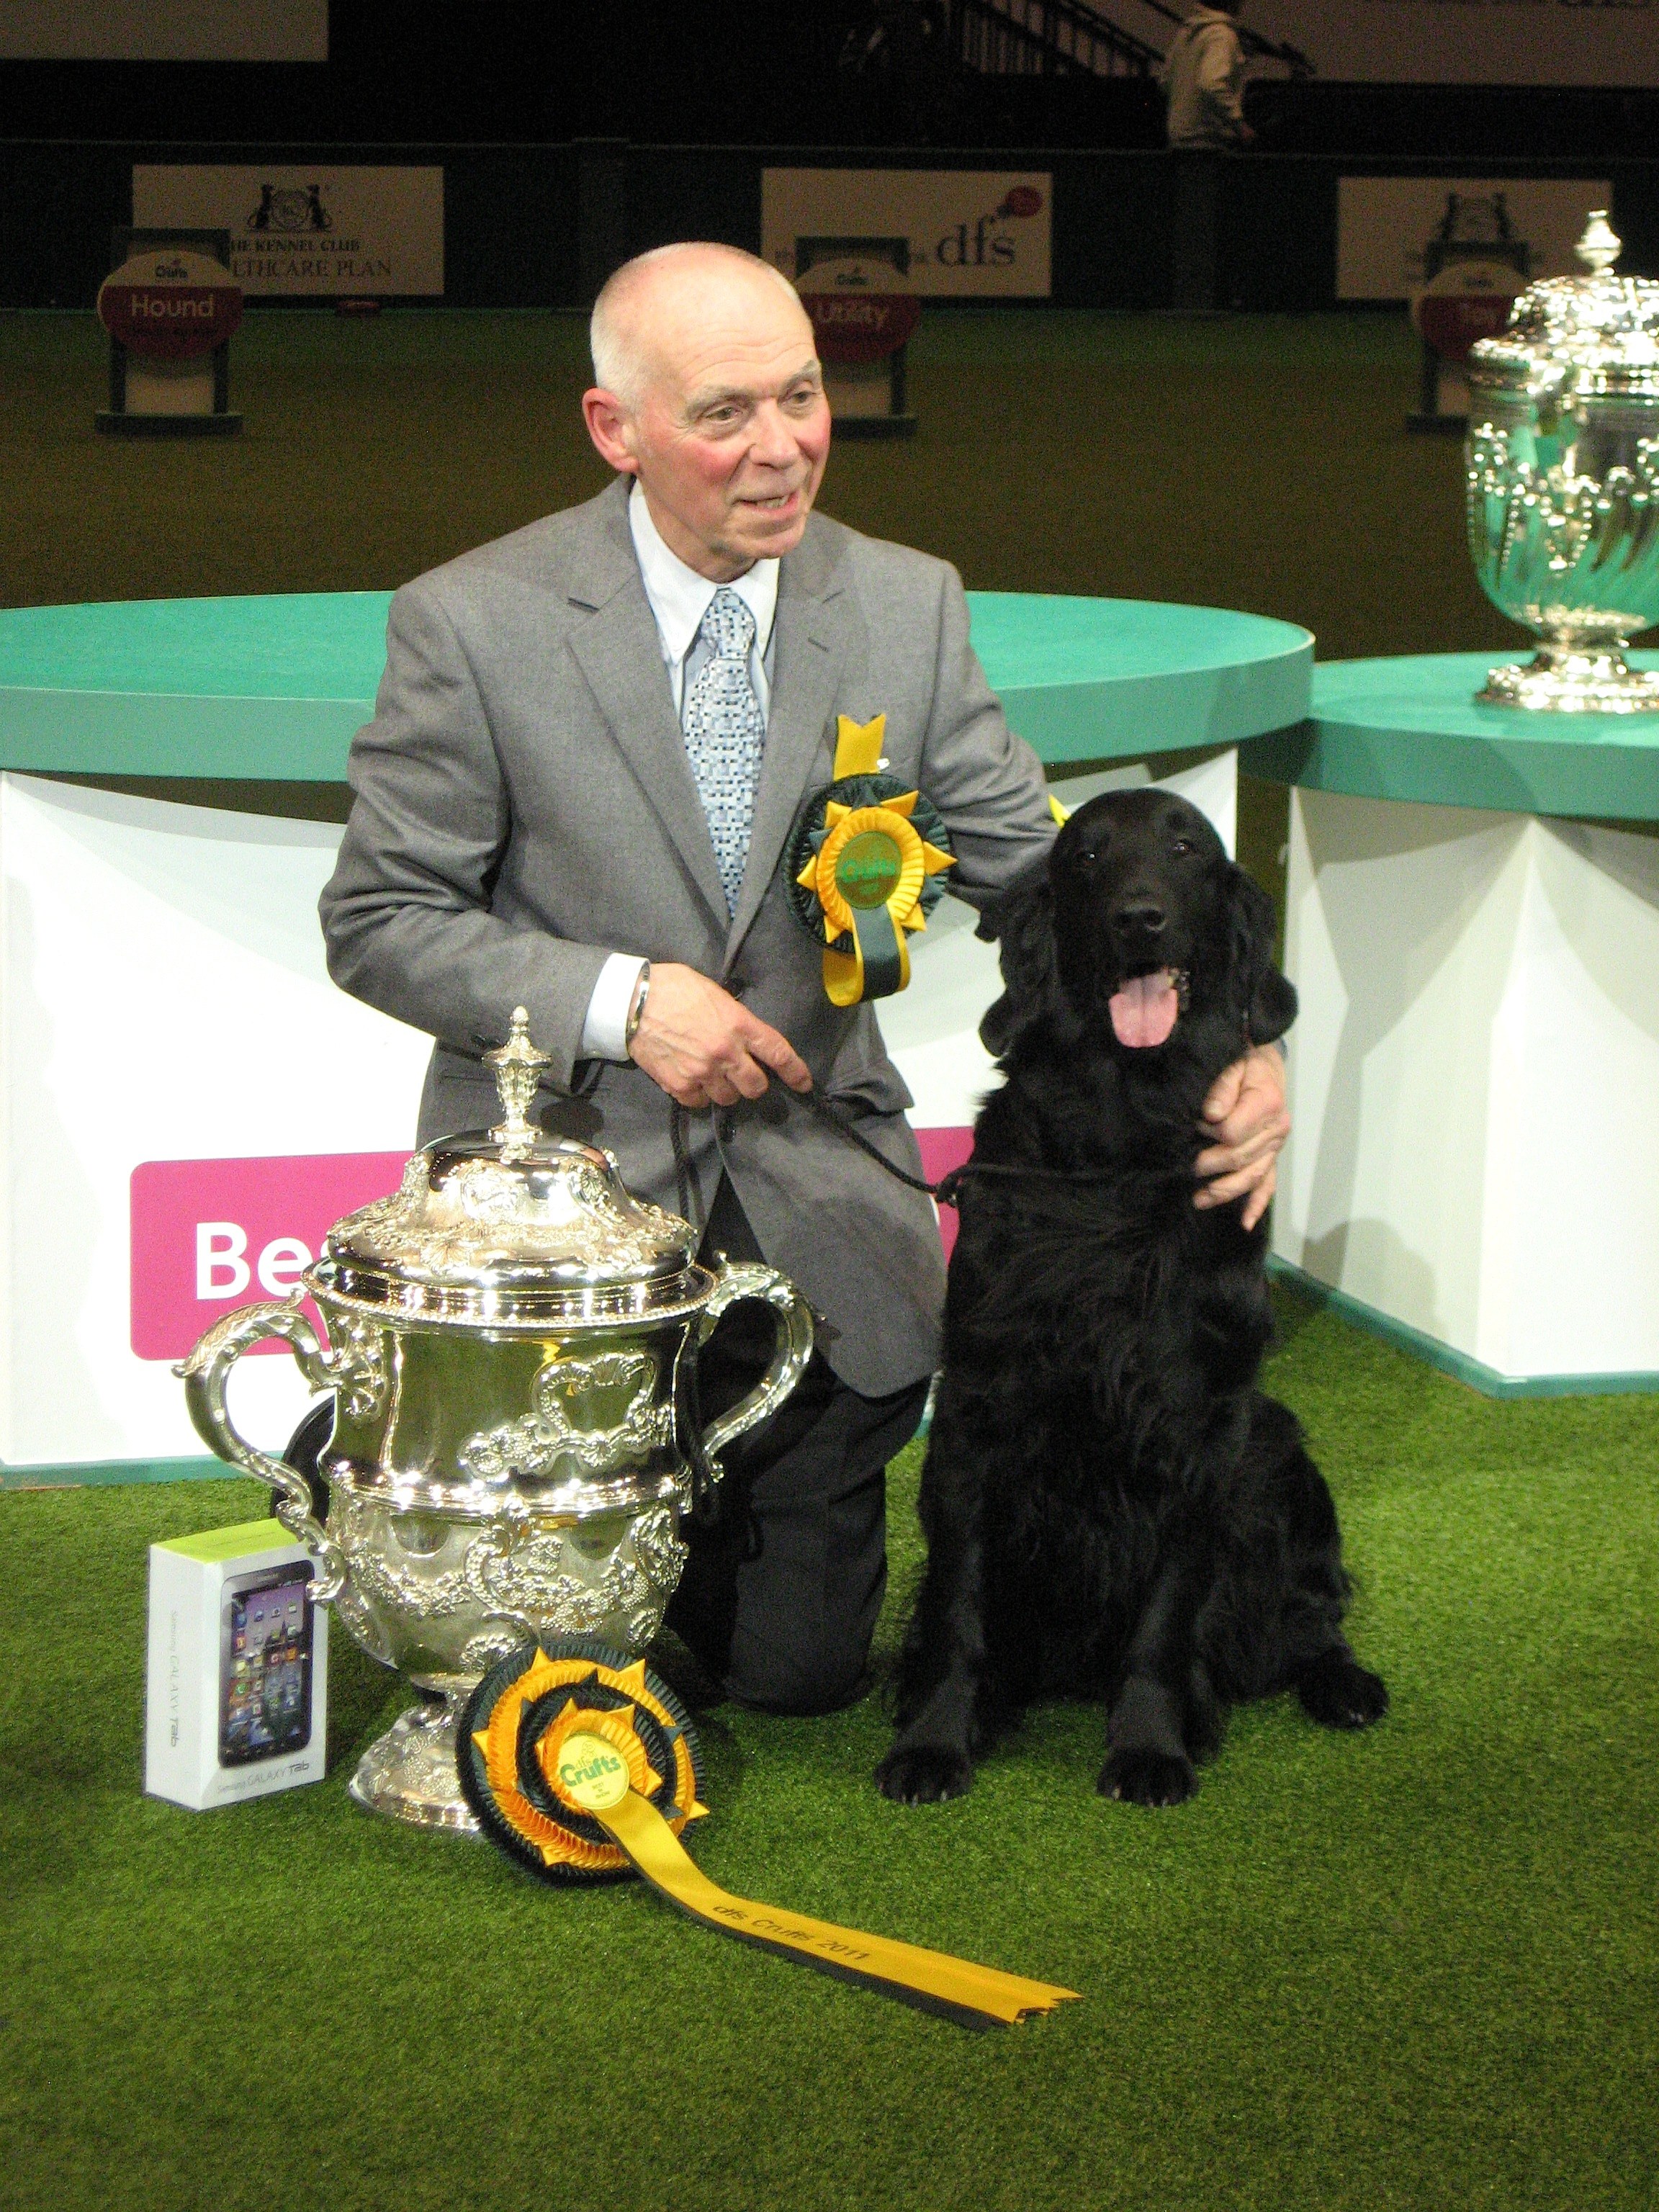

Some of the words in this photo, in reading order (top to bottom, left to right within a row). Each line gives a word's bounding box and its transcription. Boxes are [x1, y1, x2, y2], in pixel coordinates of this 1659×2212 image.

[255, 240, 314, 251] KENNEL
[320, 240, 360, 251] CLUB
[938, 217, 1015, 266] dfs
[233, 260, 329, 277] LTHCARE
[336, 260, 392, 277] PLAN
[130, 294, 215, 318] Hound
[195, 1221, 330, 1300] Be
[169, 1654, 180, 1714] GALAXY
[169, 1717, 179, 1747] Tab
[247, 1766, 287, 1787] GALAXY
[288, 1761, 310, 1776] Tab
[559, 1755, 621, 1787] Crufts
[712, 1905, 748, 1920] dfs
[752, 1919, 814, 1941] Crufts
[817, 1940, 870, 1960] 2011
